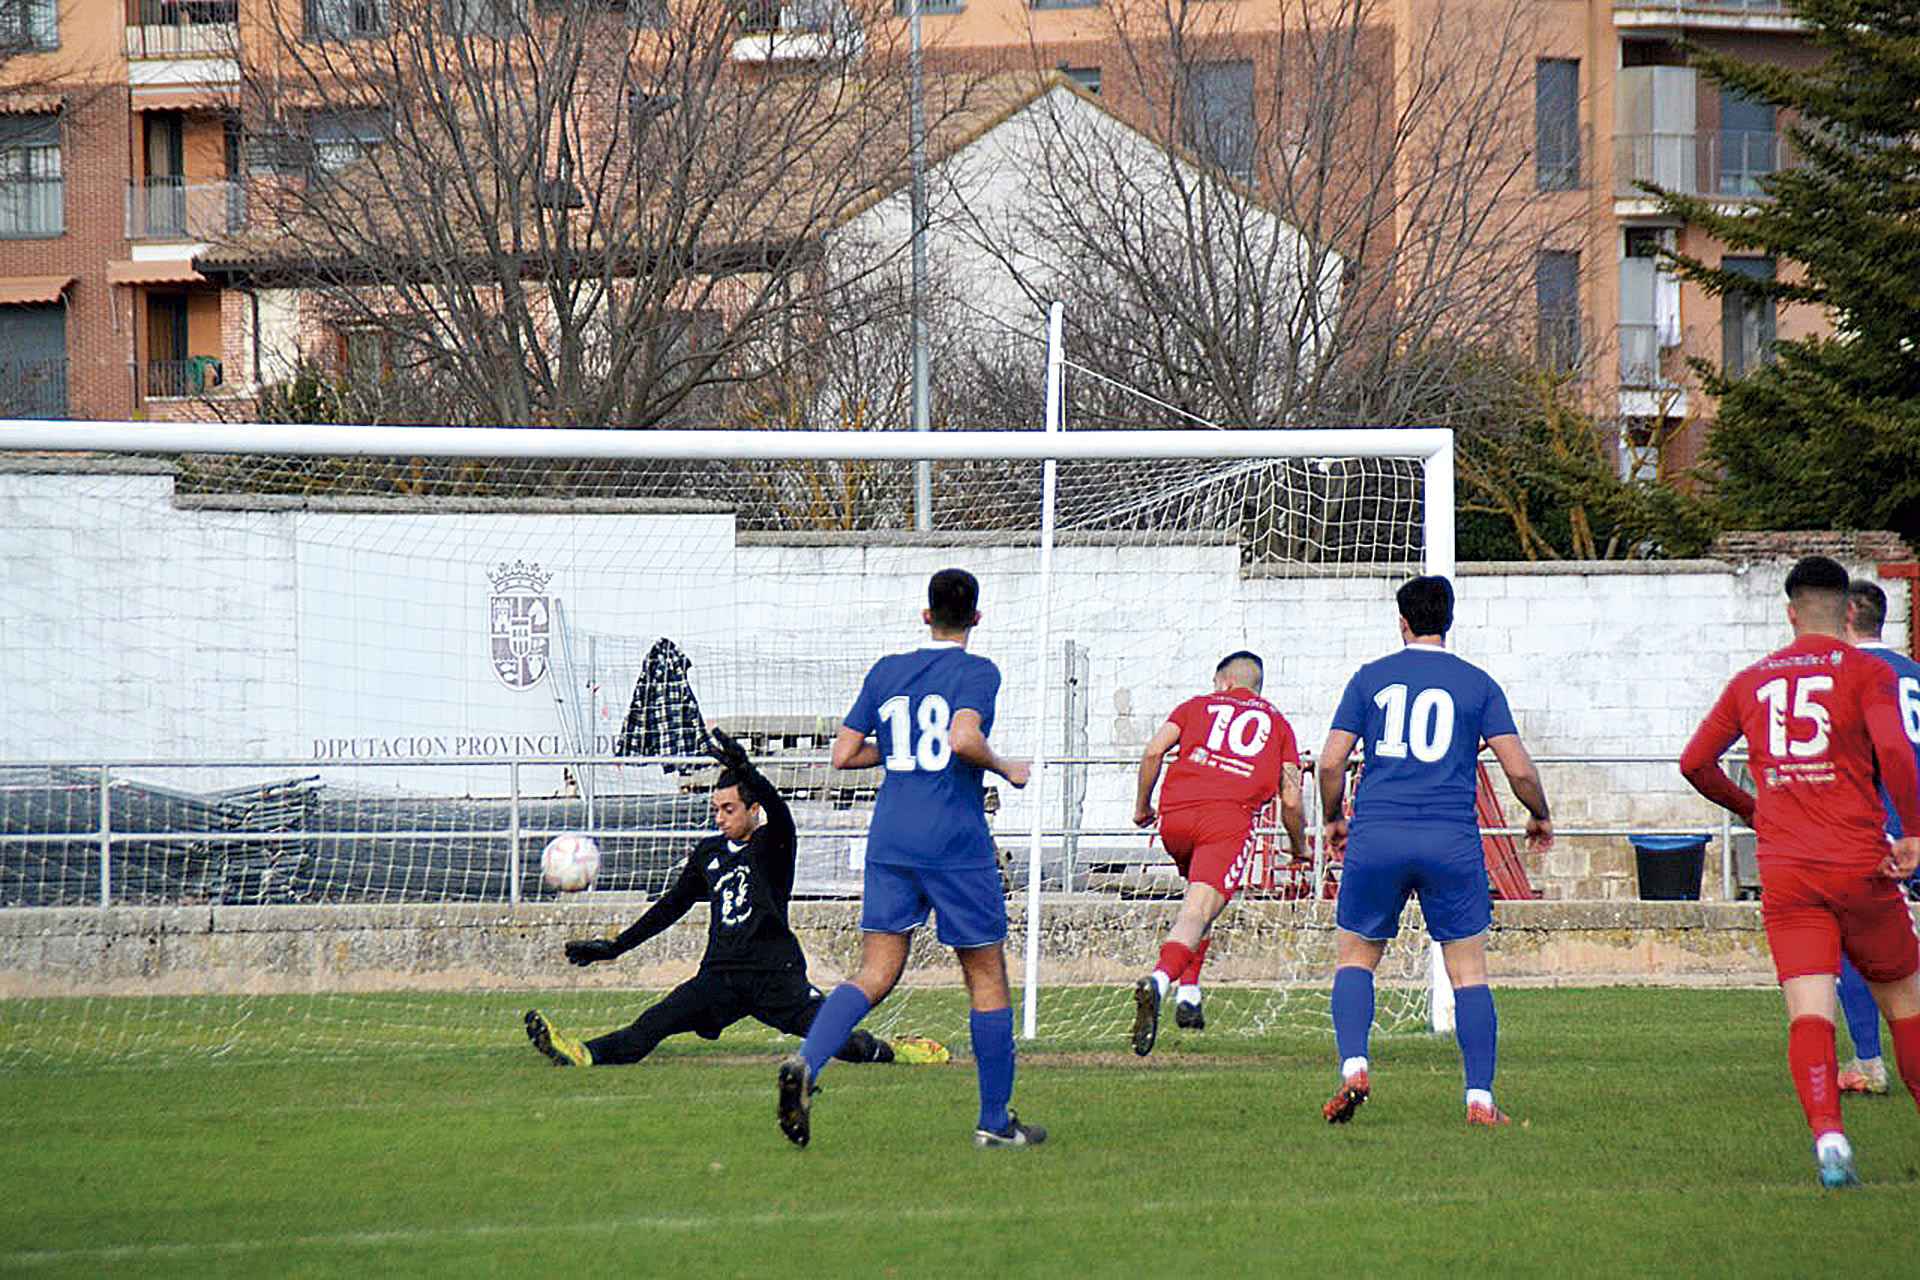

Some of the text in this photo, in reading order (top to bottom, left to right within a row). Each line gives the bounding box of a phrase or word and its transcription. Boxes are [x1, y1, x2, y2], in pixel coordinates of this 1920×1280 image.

[313, 736, 447, 759] DIPUTACION
[878, 694, 952, 771] 18
[1207, 704, 1271, 757] 70
[1374, 684, 1454, 762] 10
[1756, 676, 1833, 757] 15
